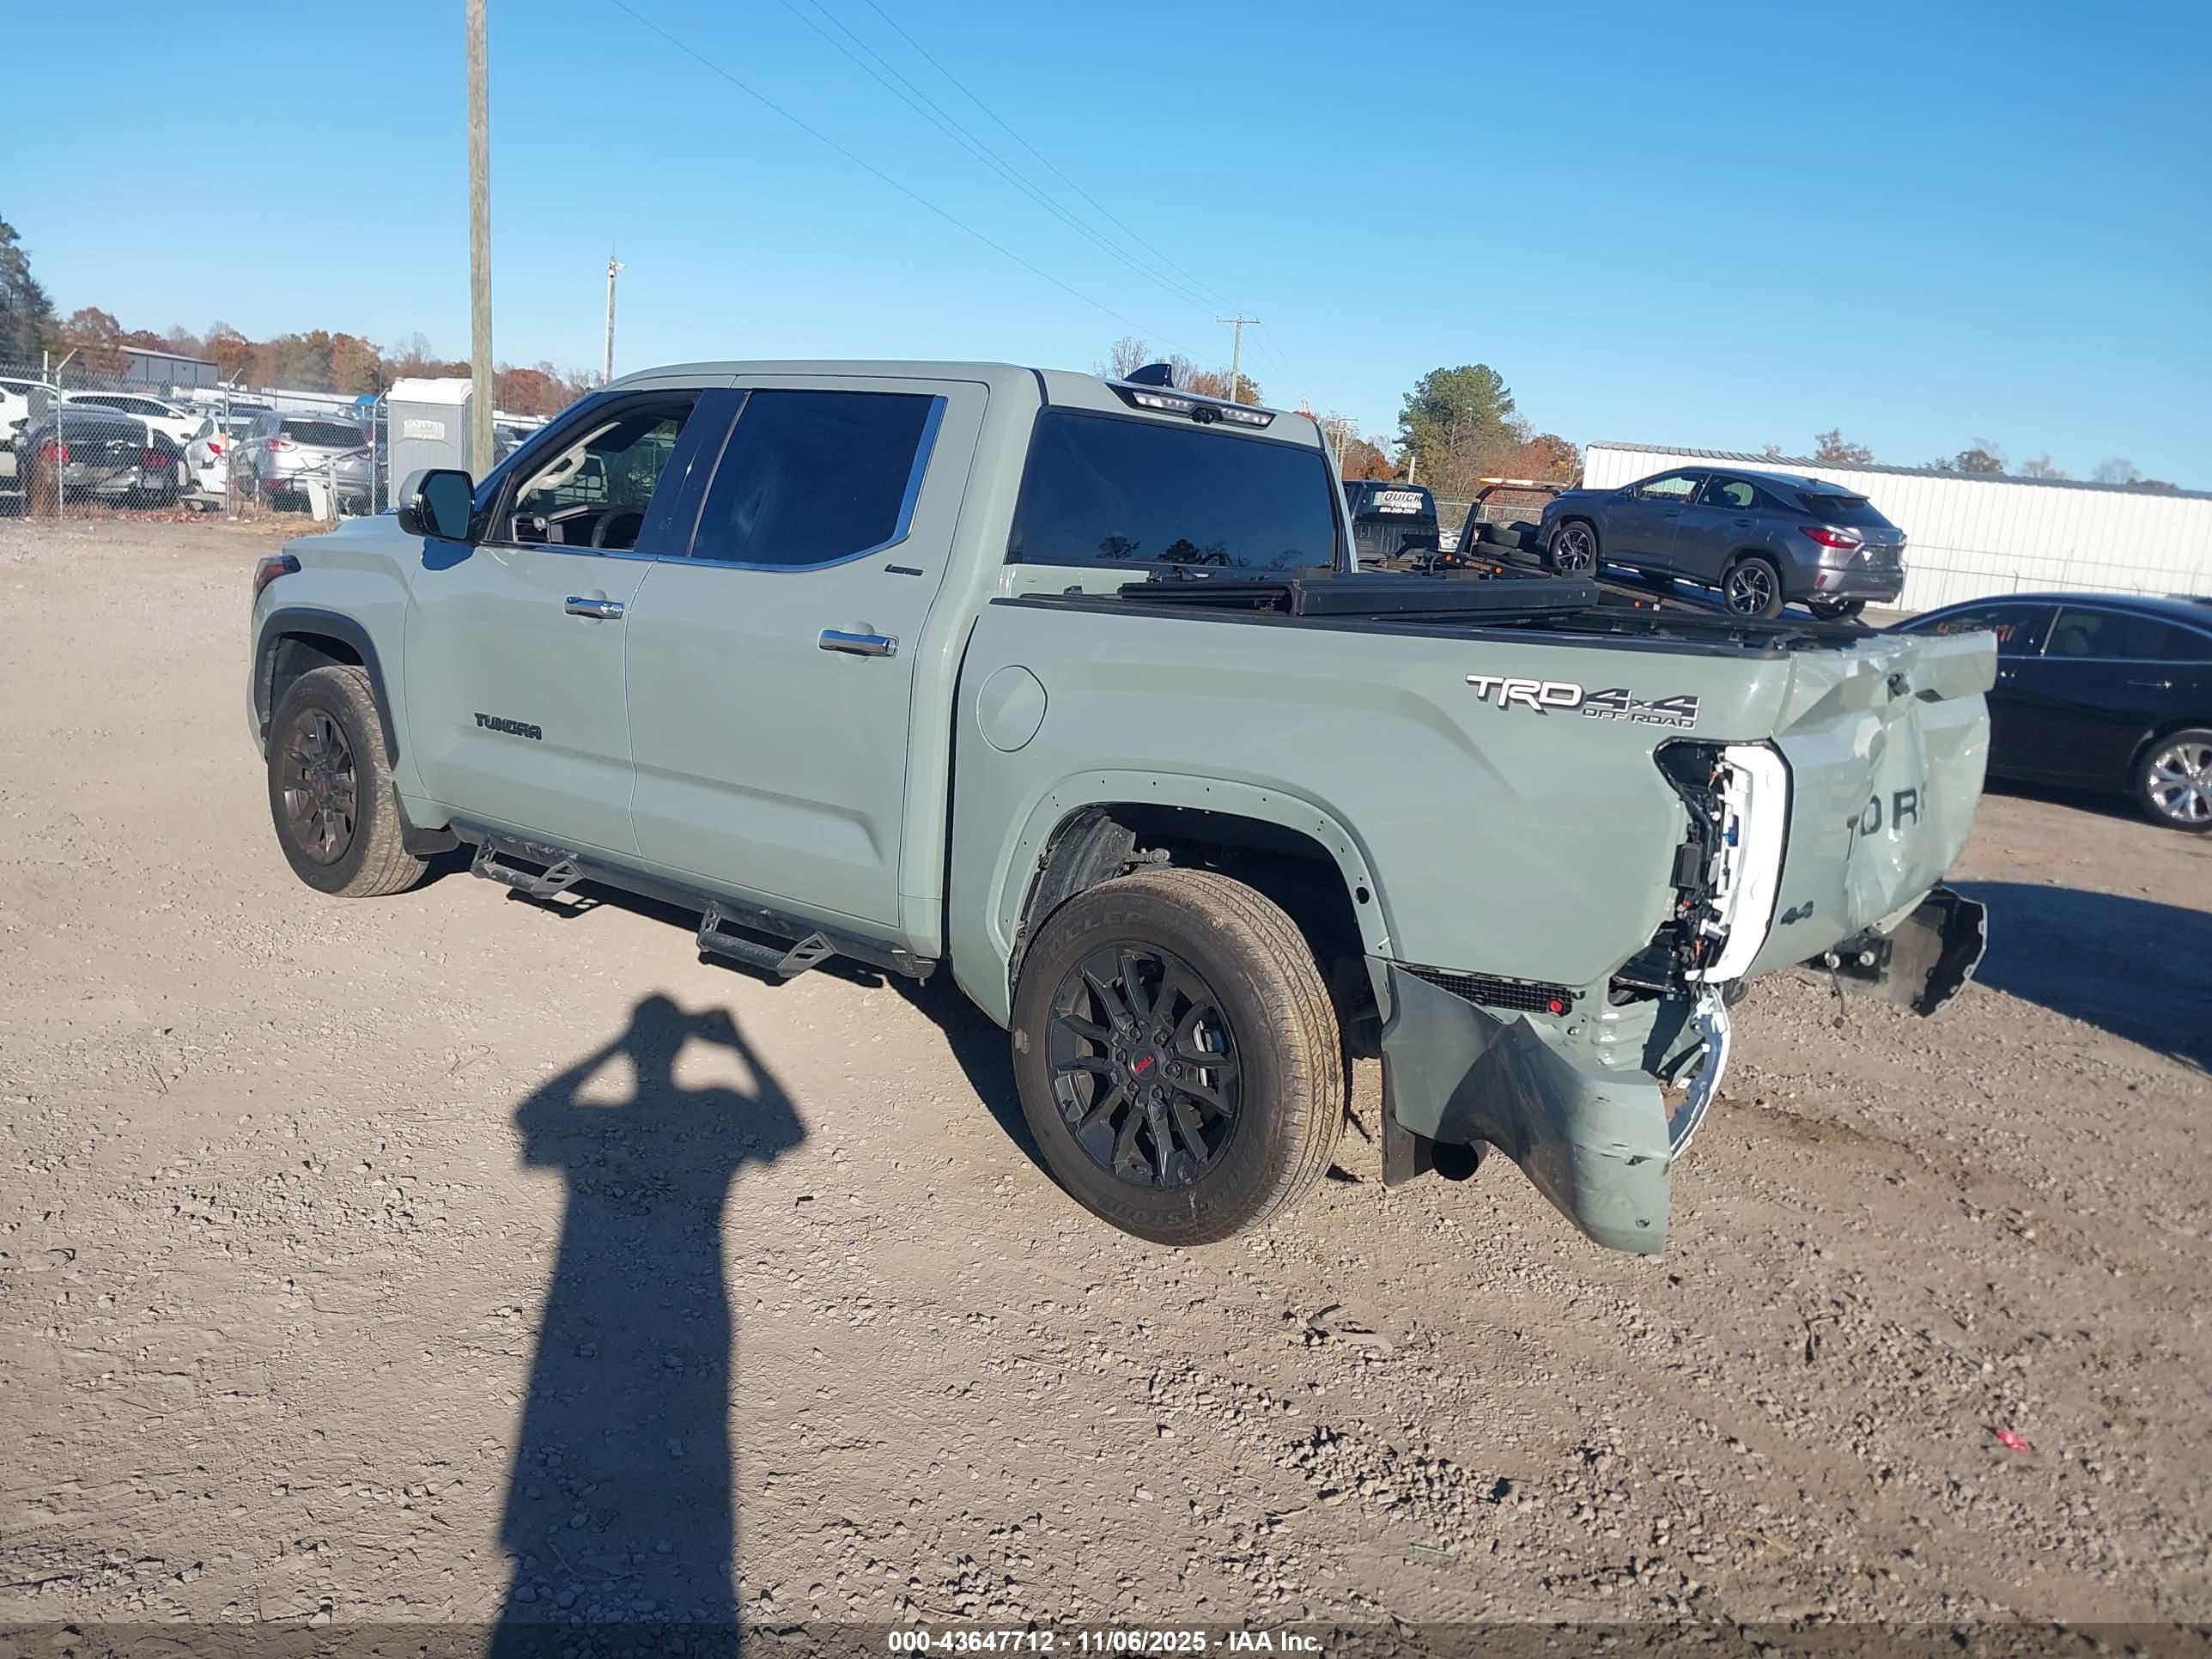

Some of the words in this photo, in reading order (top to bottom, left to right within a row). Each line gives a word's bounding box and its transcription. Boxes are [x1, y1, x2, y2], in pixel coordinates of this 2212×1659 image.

[1383, 491, 1423, 502] QUICK
[1389, 501, 1422, 510] TOWING
[1465, 673, 1584, 715] TRD
[474, 712, 543, 740] TUNDRA
[1582, 708, 1630, 721] OFF
[1630, 714, 1697, 731] ROAD
